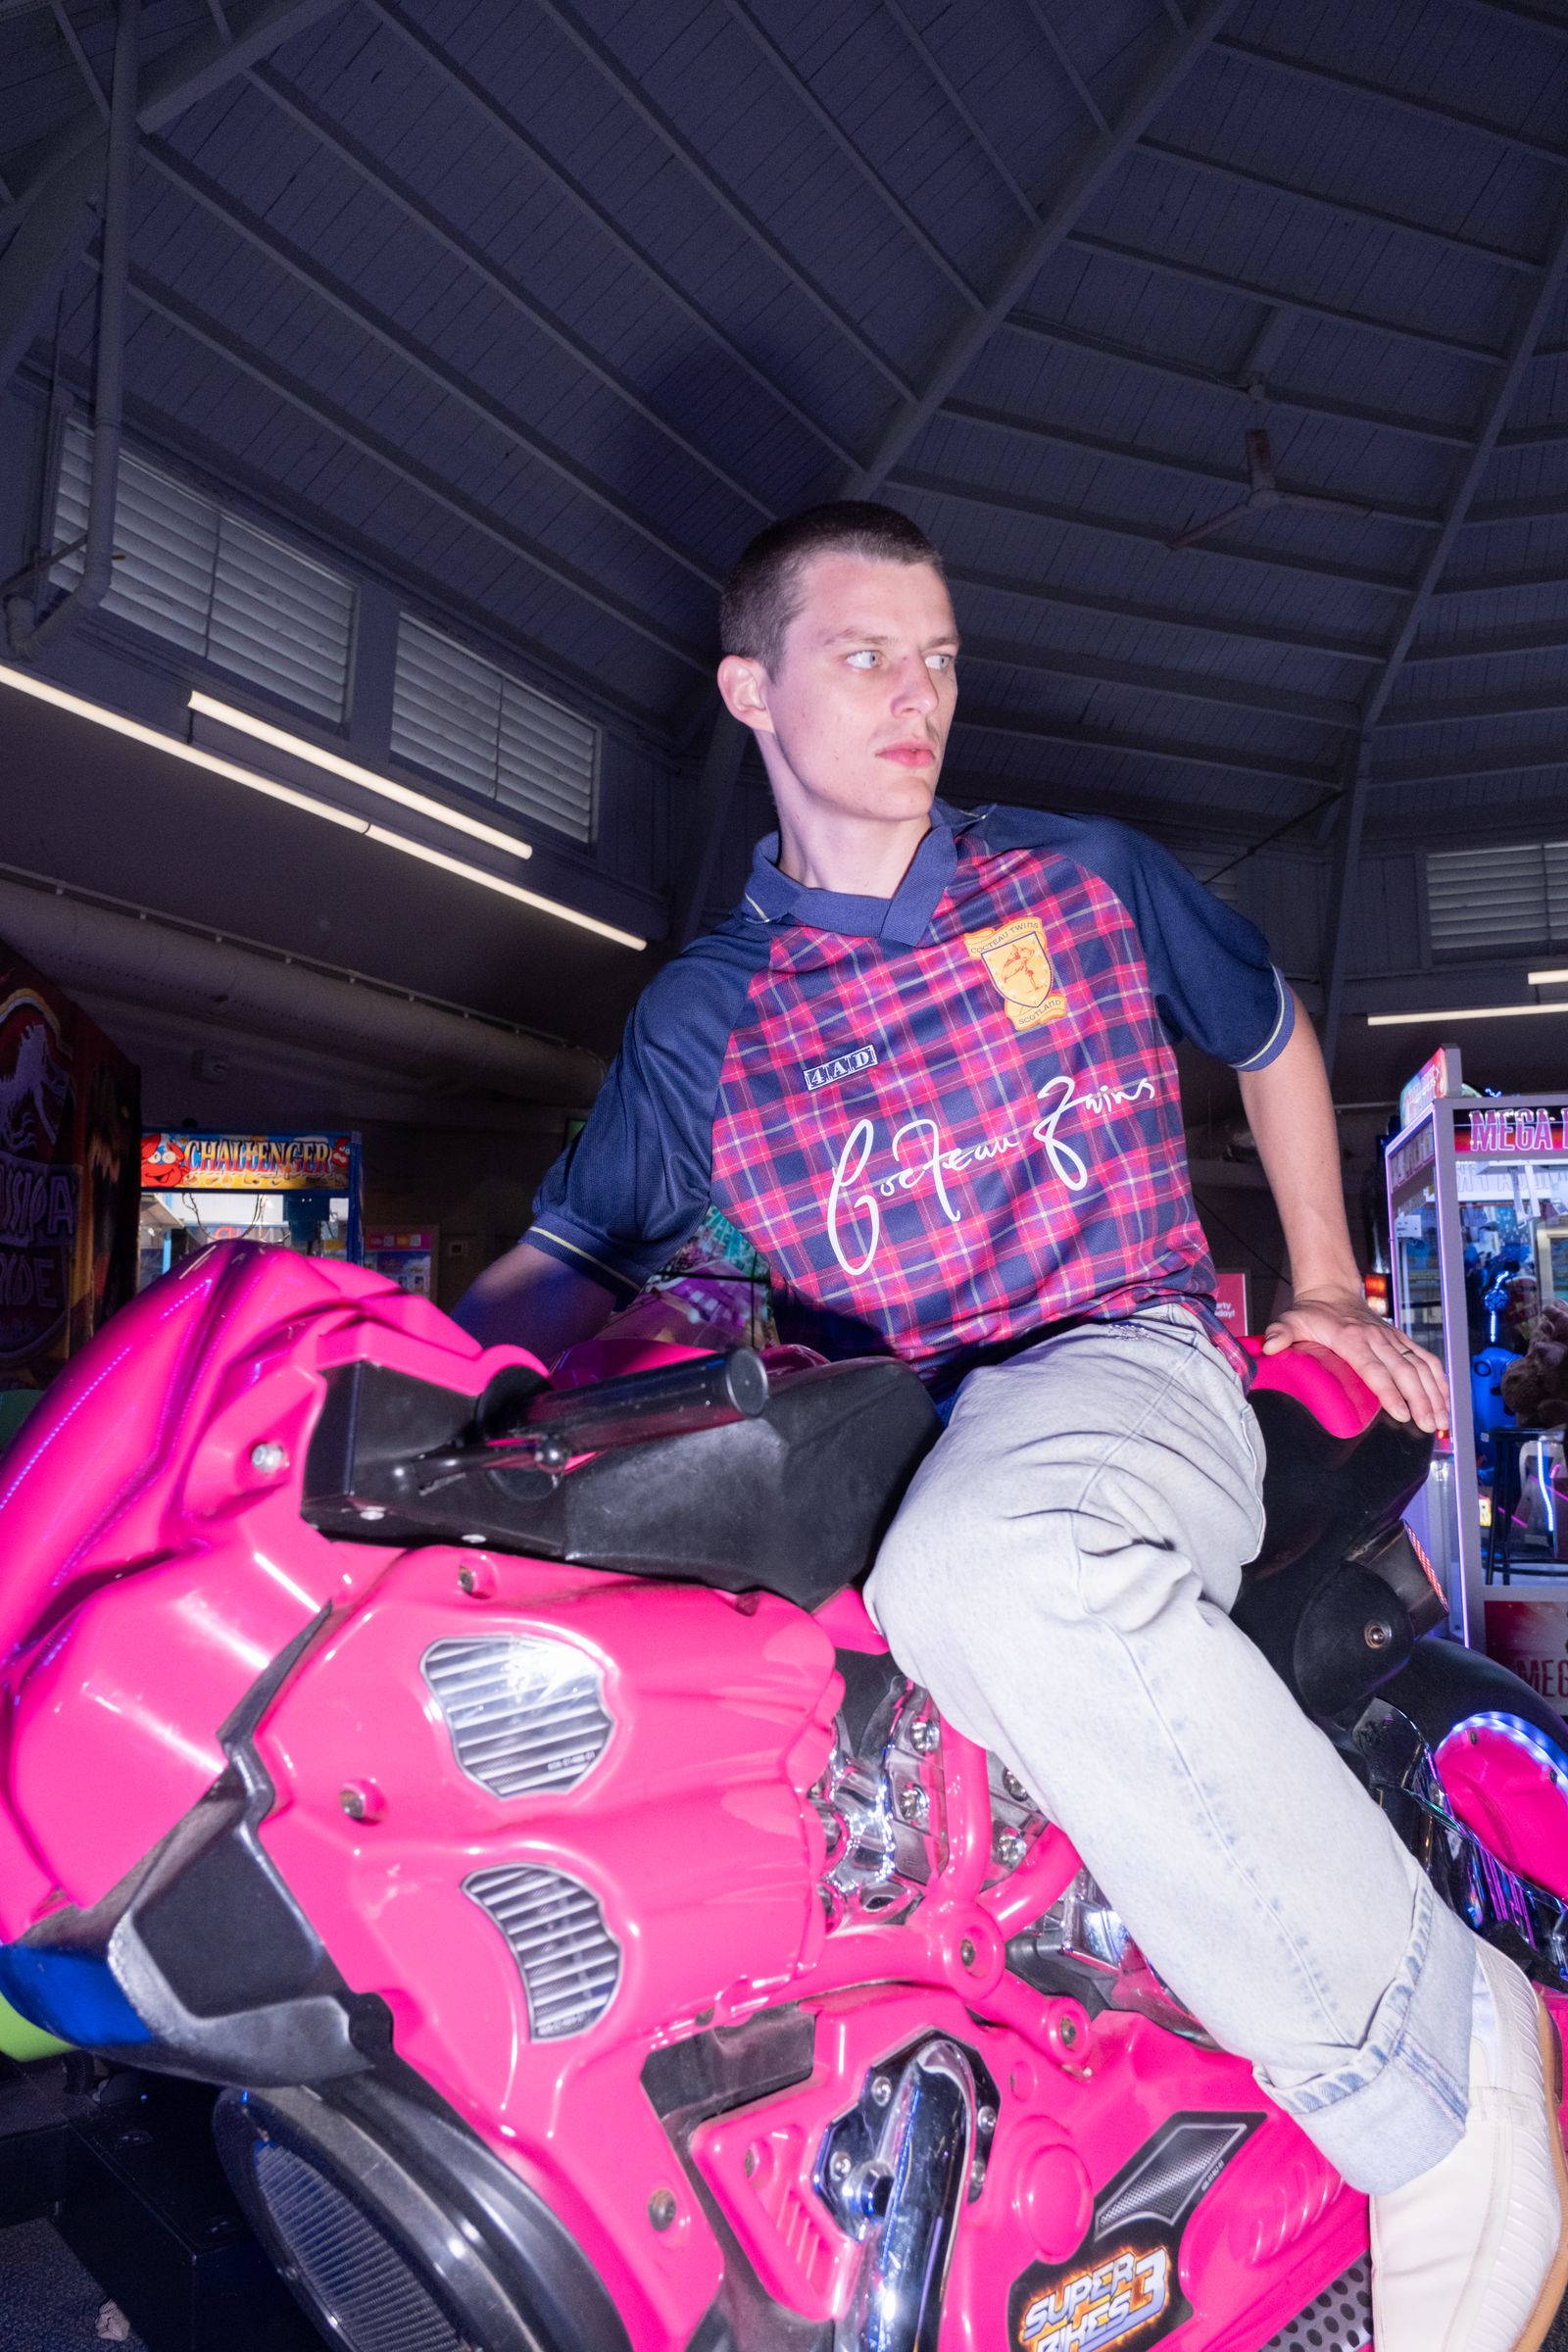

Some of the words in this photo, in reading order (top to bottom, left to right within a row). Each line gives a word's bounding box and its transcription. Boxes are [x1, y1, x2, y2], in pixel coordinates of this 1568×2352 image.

[970, 932, 1009, 955] COCTEAU
[1009, 921, 1040, 935] TWINS
[1018, 1000, 1062, 1025] SCOTLAND
[808, 1048, 873, 1087] 4AD
[1470, 1108, 1553, 1152] MEGA
[184, 1140, 332, 1176] CHALLENGER
[827, 1118, 1019, 1275] Cocteau
[1033, 1075, 1154, 1192] Twins
[1024, 2252, 1135, 2340] SUPER
